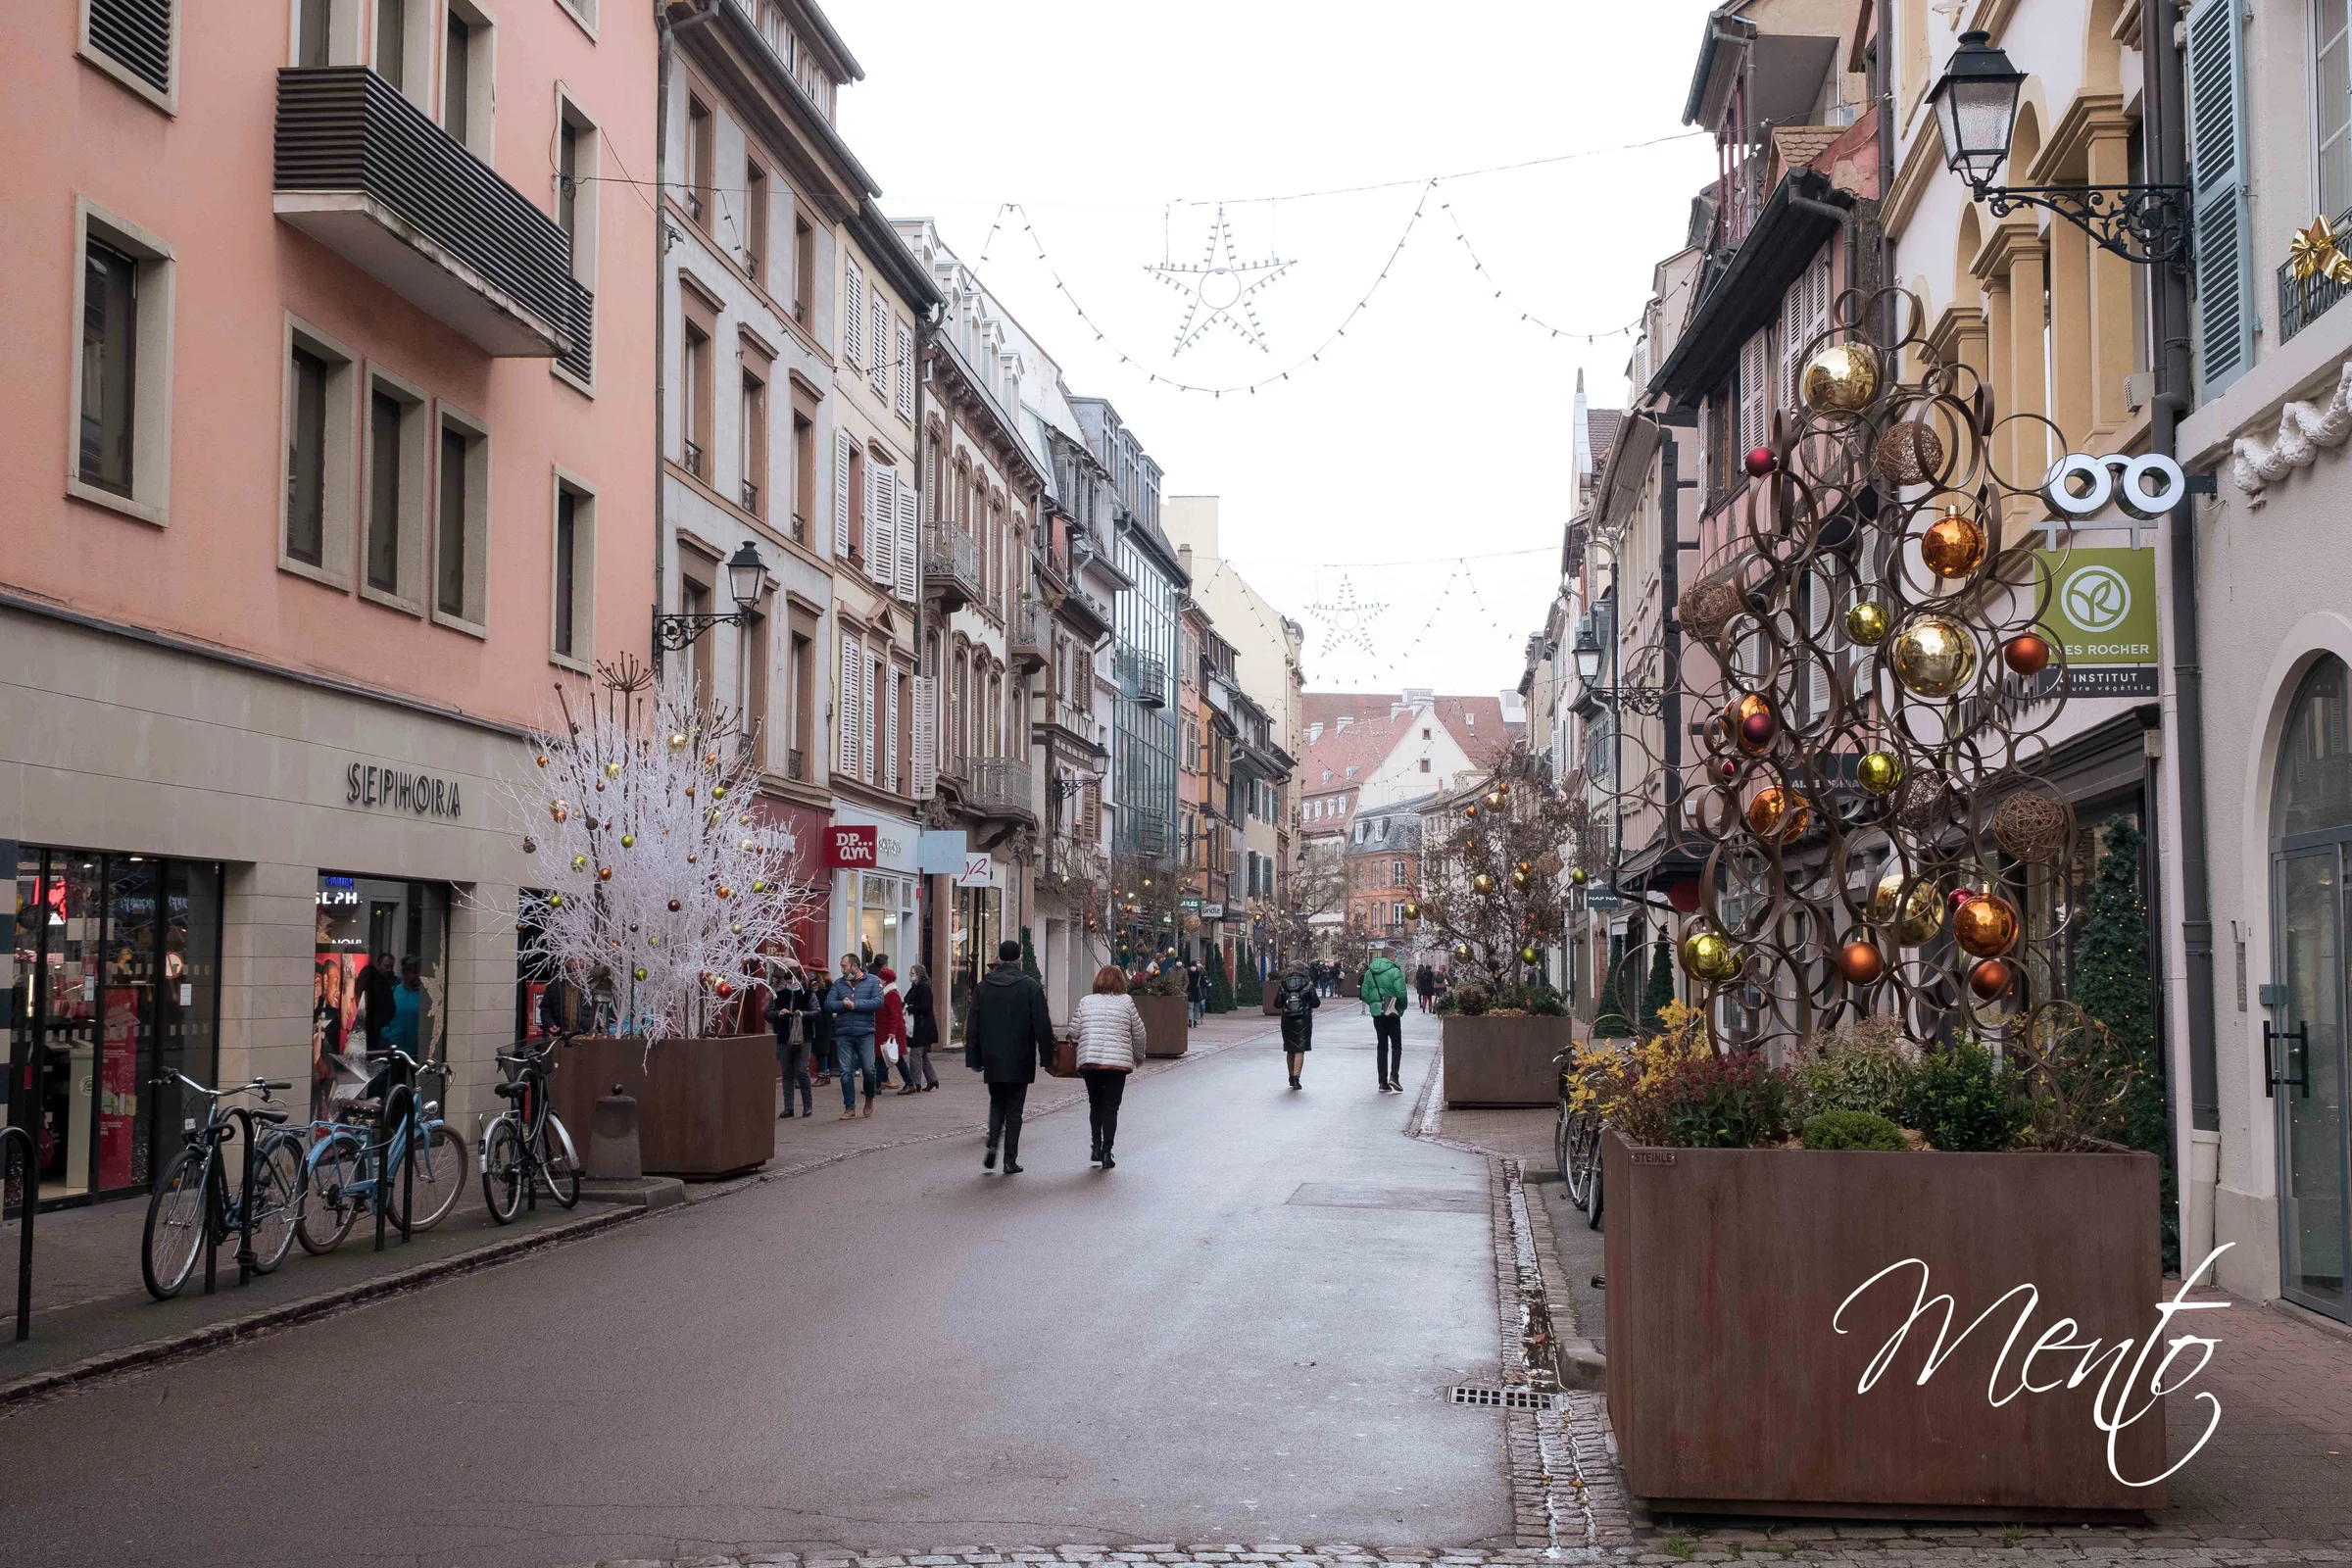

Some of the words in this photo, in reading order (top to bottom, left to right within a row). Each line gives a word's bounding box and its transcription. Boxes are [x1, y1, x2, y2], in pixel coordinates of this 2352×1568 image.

[2088, 644, 2149, 655] ROCHER
[347, 762, 462, 817] SEPHORA
[840, 846, 873, 860] am
[1634, 1152, 1672, 1163] STEINLE
